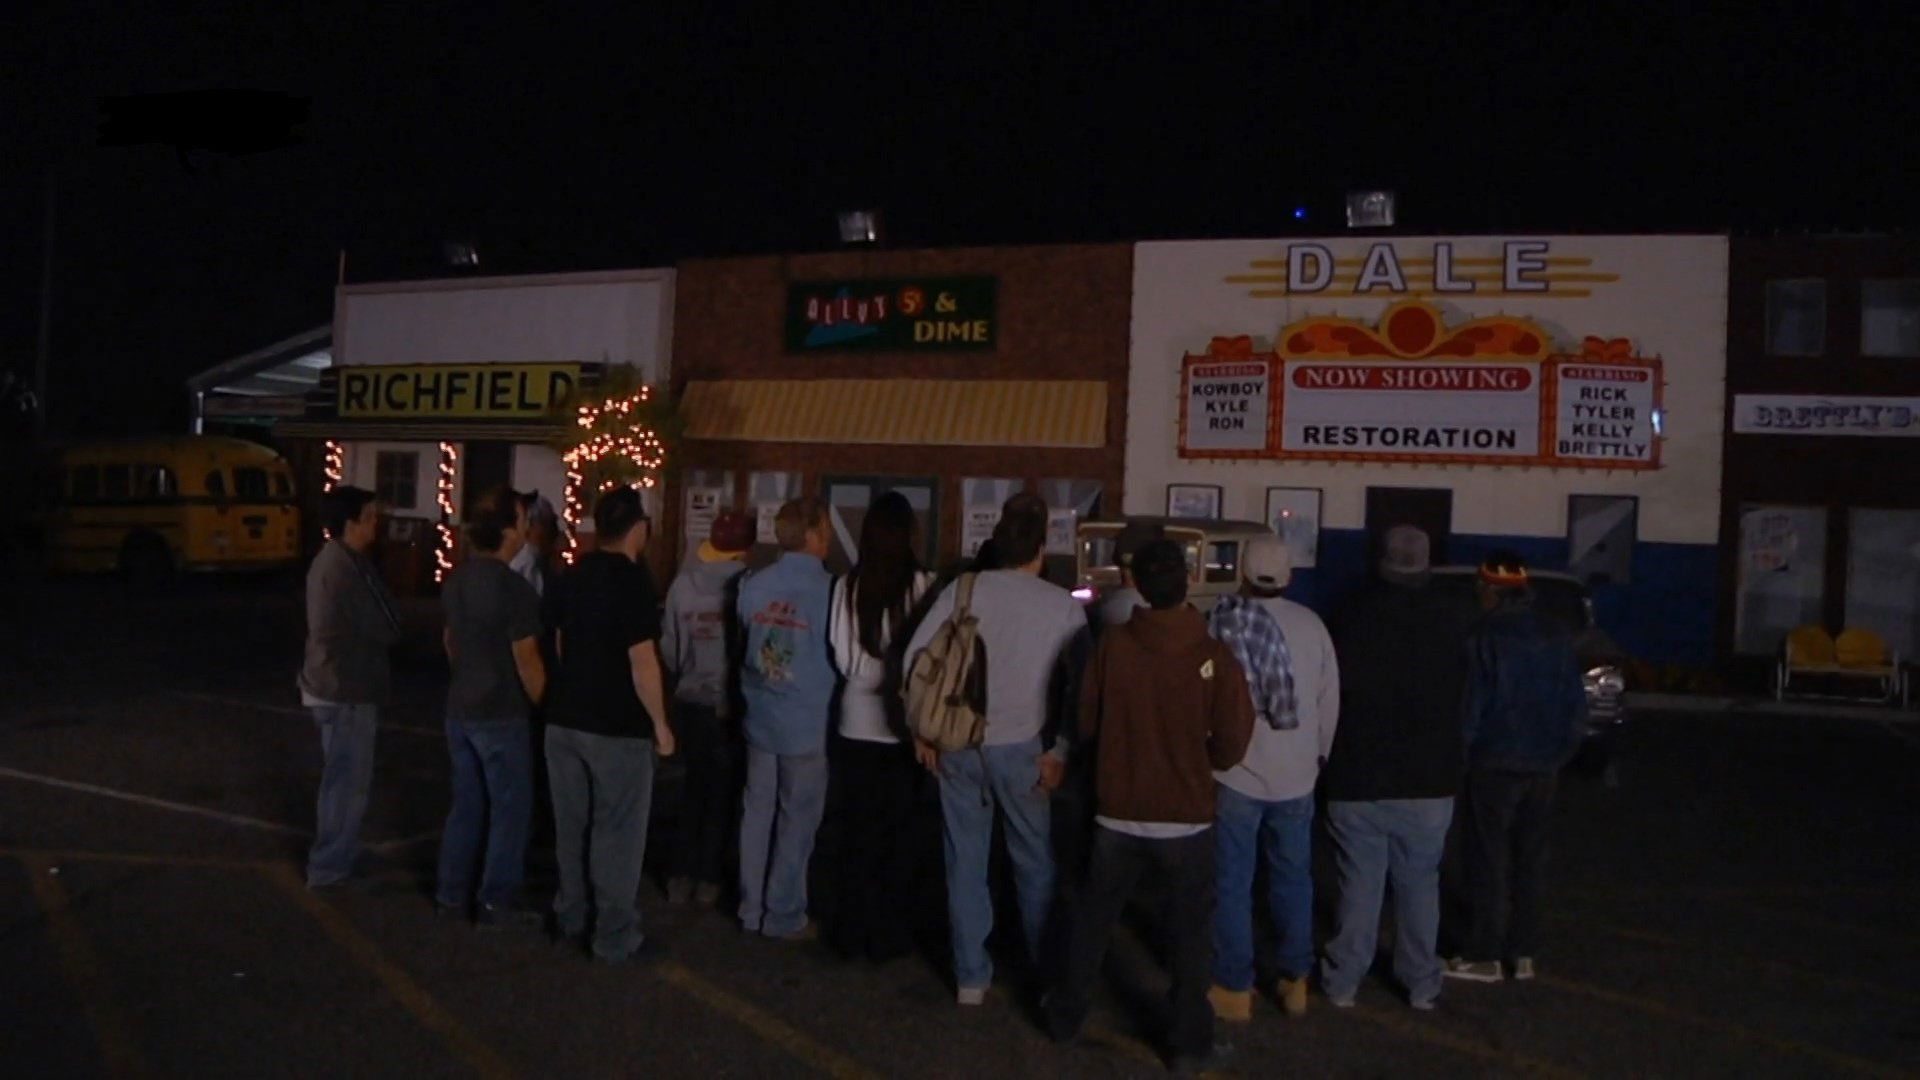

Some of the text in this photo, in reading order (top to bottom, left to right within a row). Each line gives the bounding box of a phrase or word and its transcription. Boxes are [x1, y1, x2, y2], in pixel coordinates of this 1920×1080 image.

[1286, 240, 1550, 293] DALE
[934, 290, 957, 313] &
[913, 319, 989, 343] DIME
[1305, 366, 1519, 389] NOW SHOWING
[344, 369, 577, 412] RICHFIELD
[1192, 382, 1264, 396] KOWBOY
[1580, 386, 1628, 401] RICK
[1206, 399, 1249, 413] KYLE
[1571, 403, 1635, 420] TYLER
[1209, 416, 1245, 430] RON
[1571, 423, 1634, 439] KELLY
[1303, 425, 1516, 449] RESTORATION
[1558, 439, 1647, 458] BRETTLY
